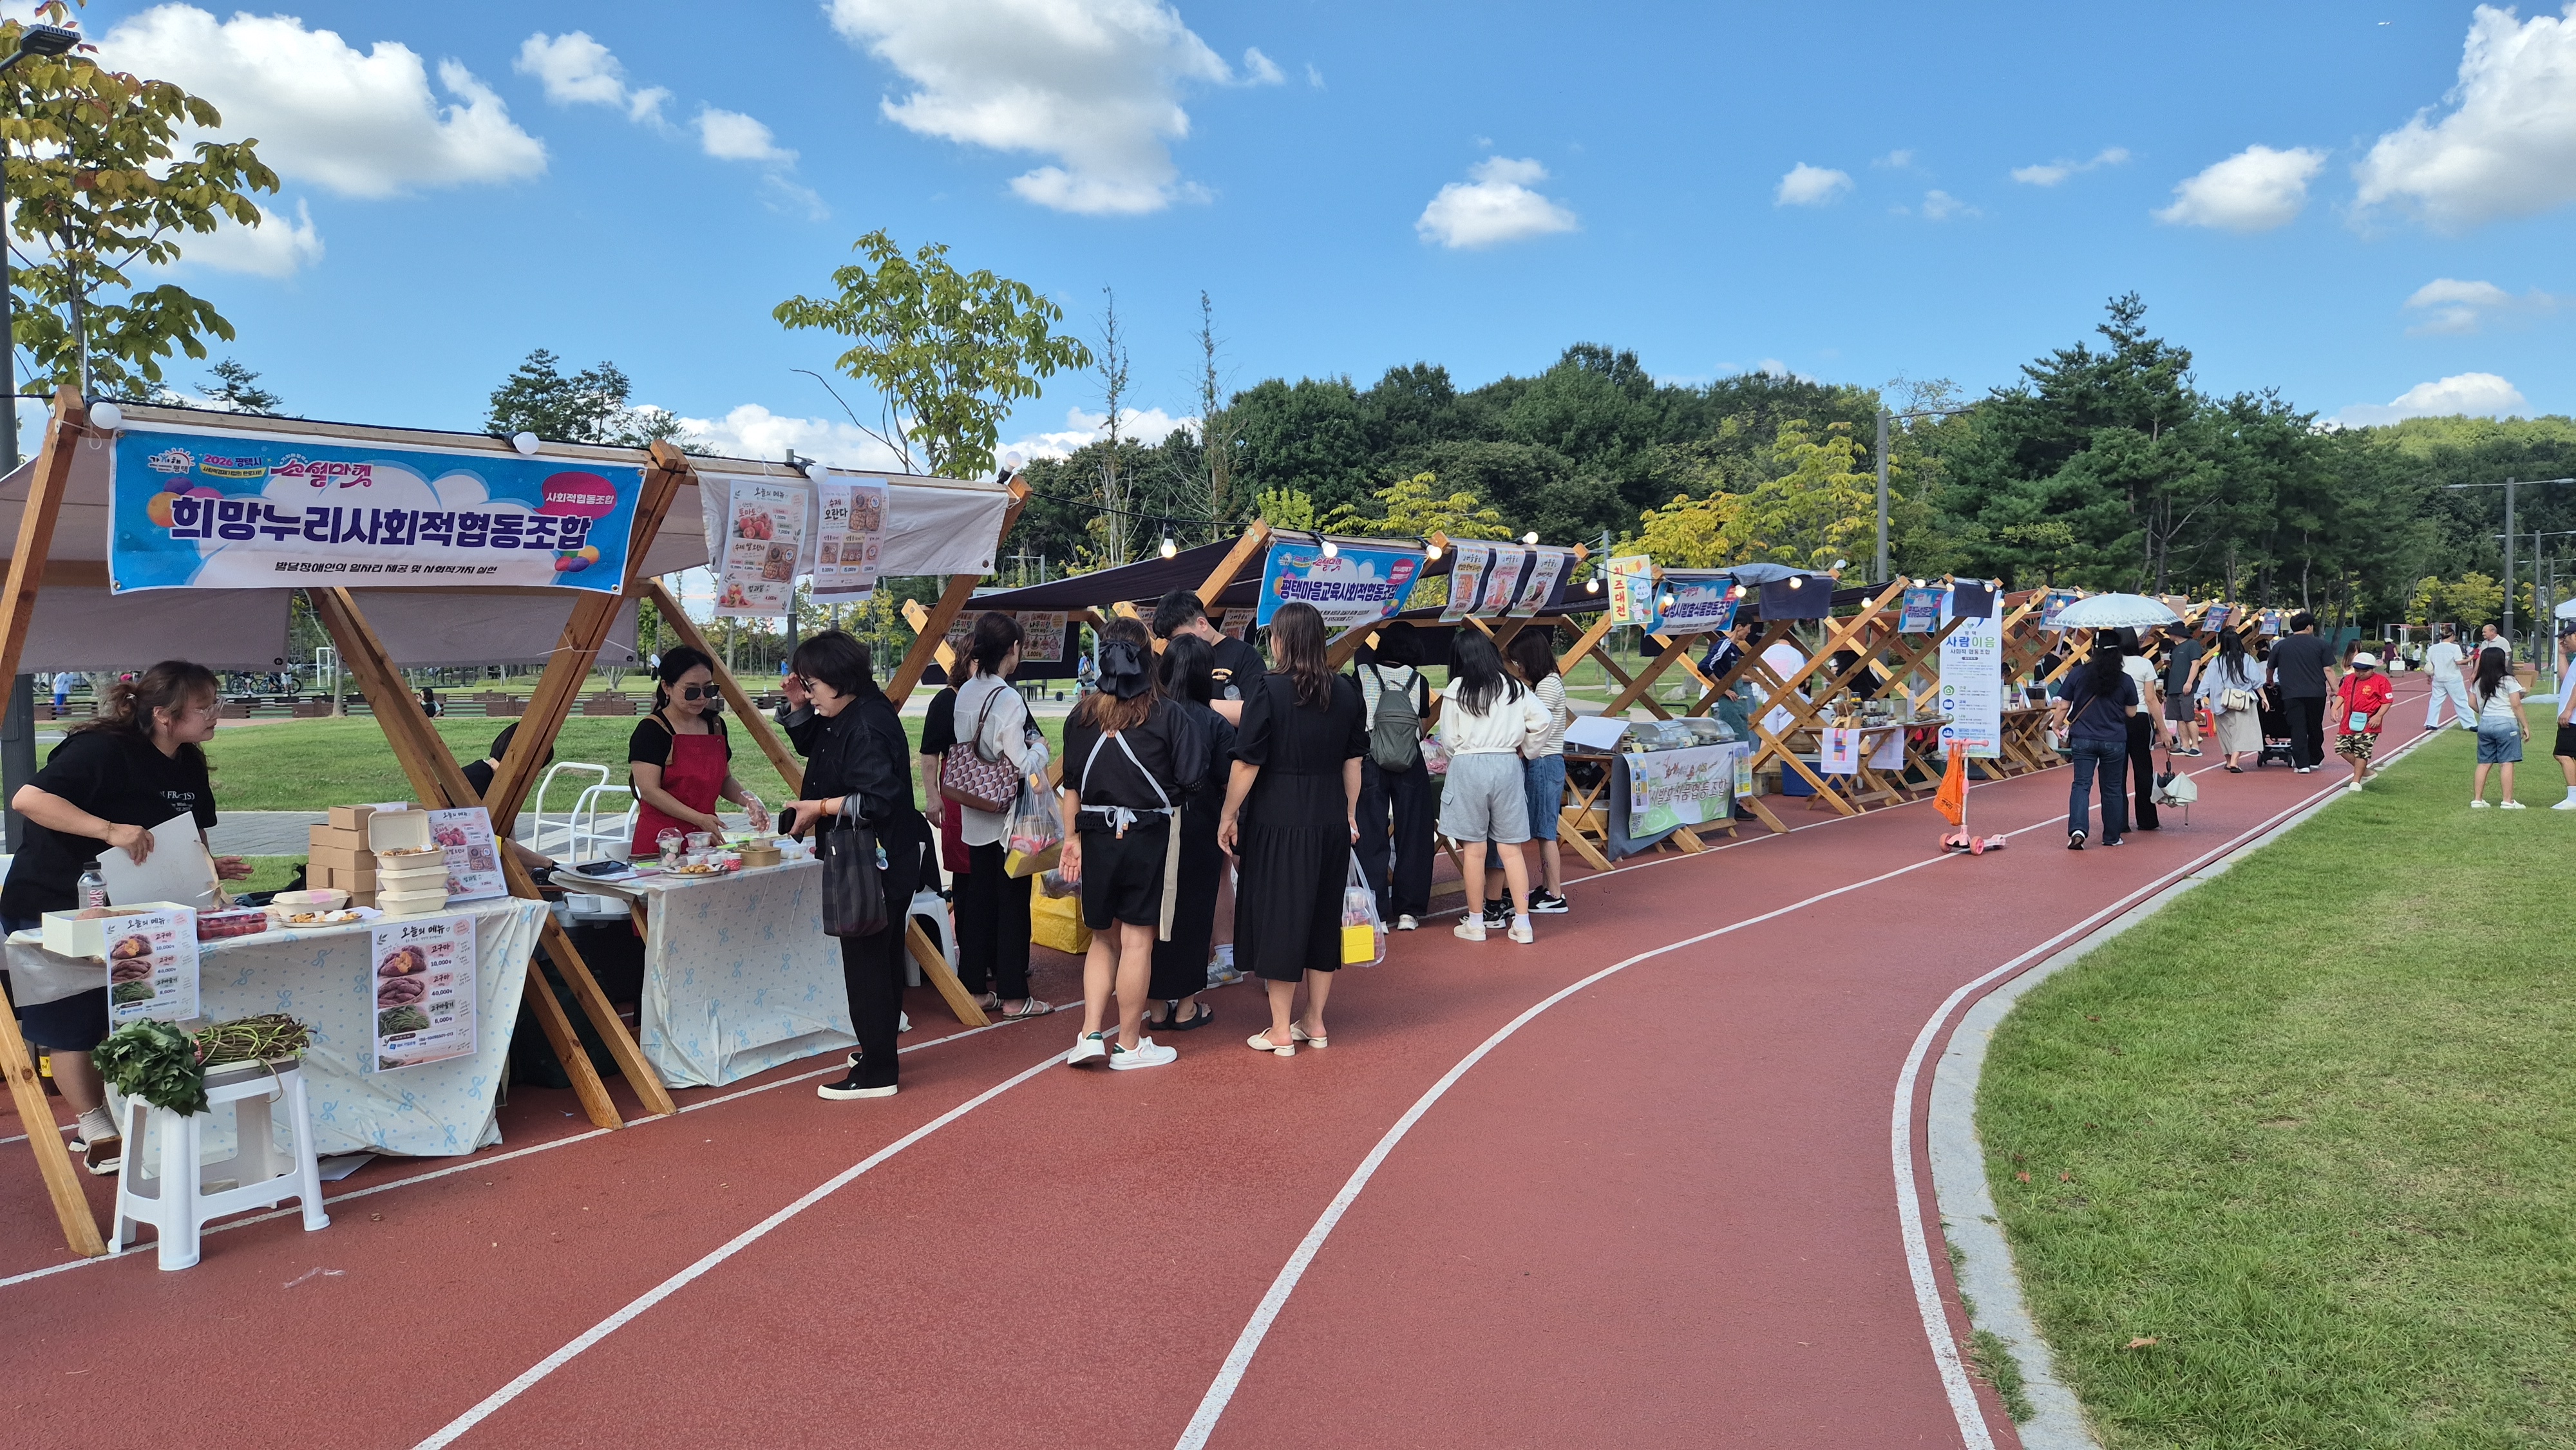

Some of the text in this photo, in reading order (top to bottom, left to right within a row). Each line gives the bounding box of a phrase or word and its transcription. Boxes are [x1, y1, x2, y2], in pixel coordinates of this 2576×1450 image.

[235, 457, 261, 467] 평택시
[546, 492, 614, 505] 사회적협동조합
[754, 487, 784, 499] 오늘의 메뉴
[829, 498, 841, 507] 수제
[739, 507, 757, 518] 토마토
[824, 507, 848, 520] 오란다
[172, 497, 591, 550] 희망누리사회적협동조합
[275, 561, 346, 572] 발달장애인의
[349, 563, 383, 572] 일자리
[385, 565, 409, 573] 제공
[410, 565, 421, 574] 및
[477, 566, 498, 574] 실현
[748, 584, 764, 592] 컵과일
[1280, 579, 1399, 602] 평택마을교육사회적협동조합
[1613, 565, 1626, 617] 치즈대전
[1030, 620, 1050, 629] 나무키링
[1946, 636, 1995, 648] 사람이음
[1649, 778, 1728, 806] 시발효식품협동조합
[90, 889, 104, 907] SPR
[128, 919, 147, 929] 오늘의
[155, 932, 173, 940] 고구마
[401, 926, 425, 939] 오늘의
[428, 925, 445, 934] 메뉴
[431, 943, 451, 953] 고구마
[433, 973, 451, 983] 고구마
